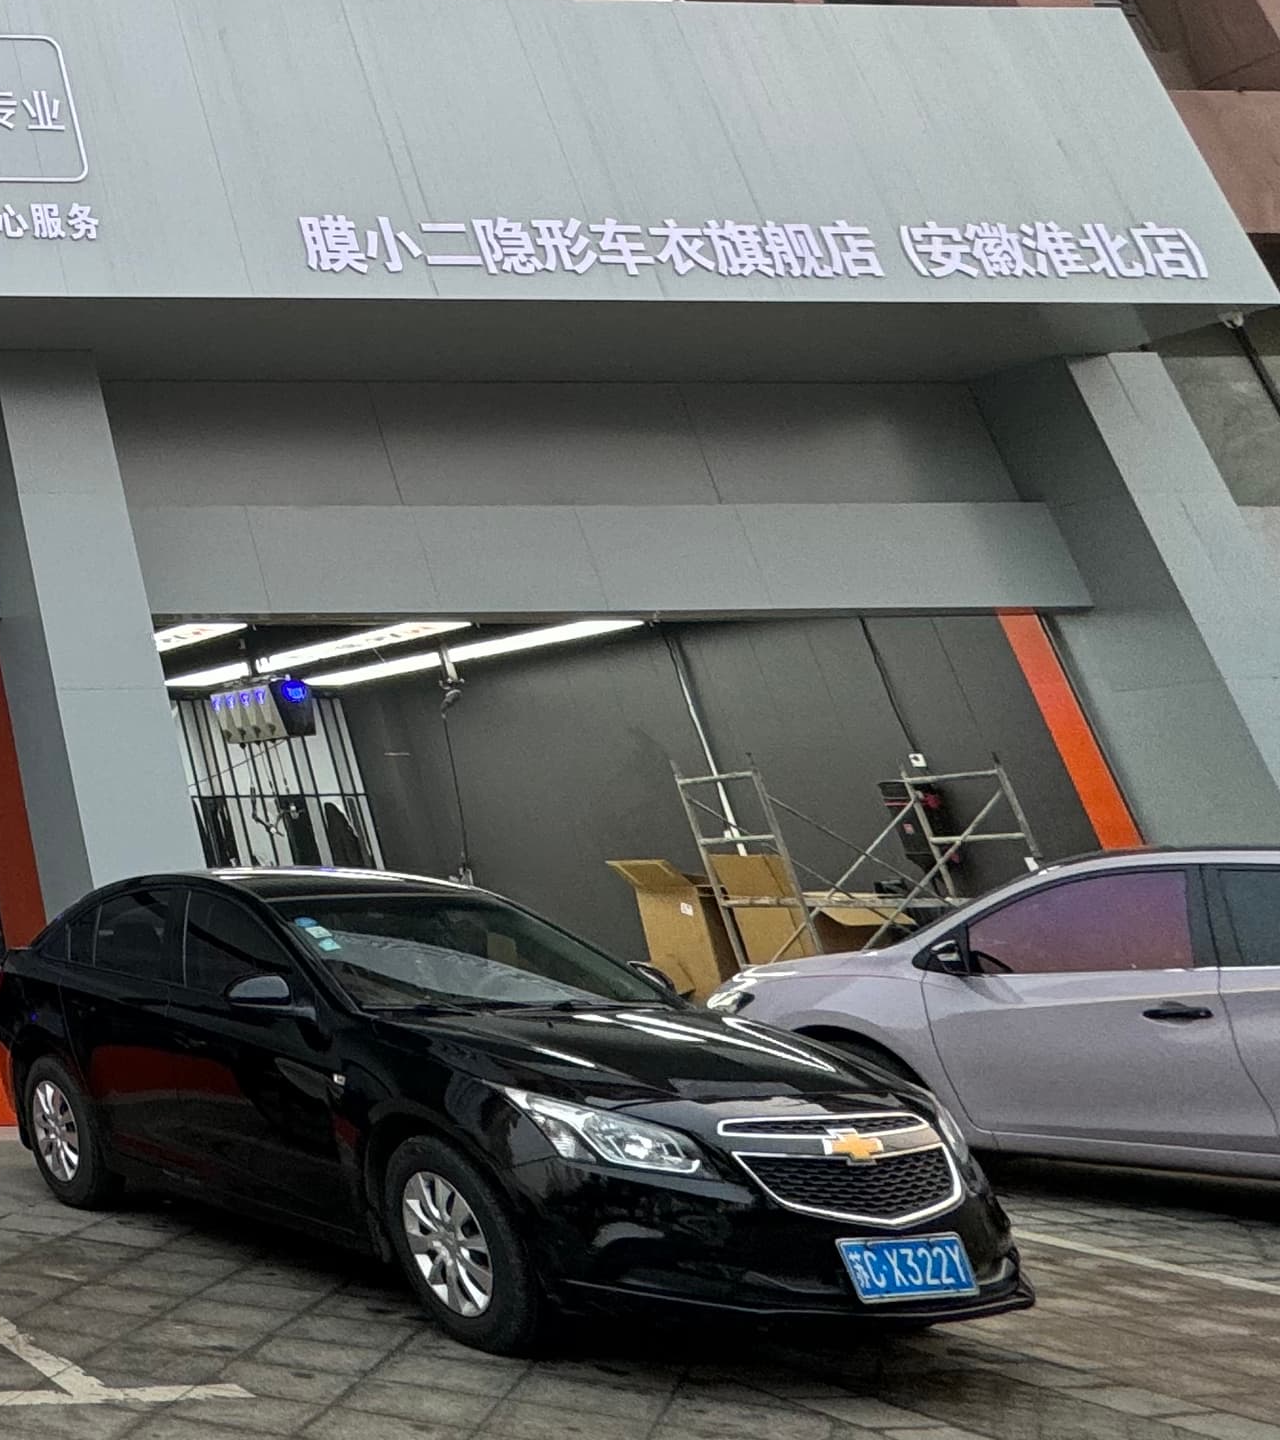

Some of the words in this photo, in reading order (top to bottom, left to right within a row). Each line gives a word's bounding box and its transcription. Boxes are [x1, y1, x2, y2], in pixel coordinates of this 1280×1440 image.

[299, 215, 886, 278] 膜小二隐形车衣旗舰店
